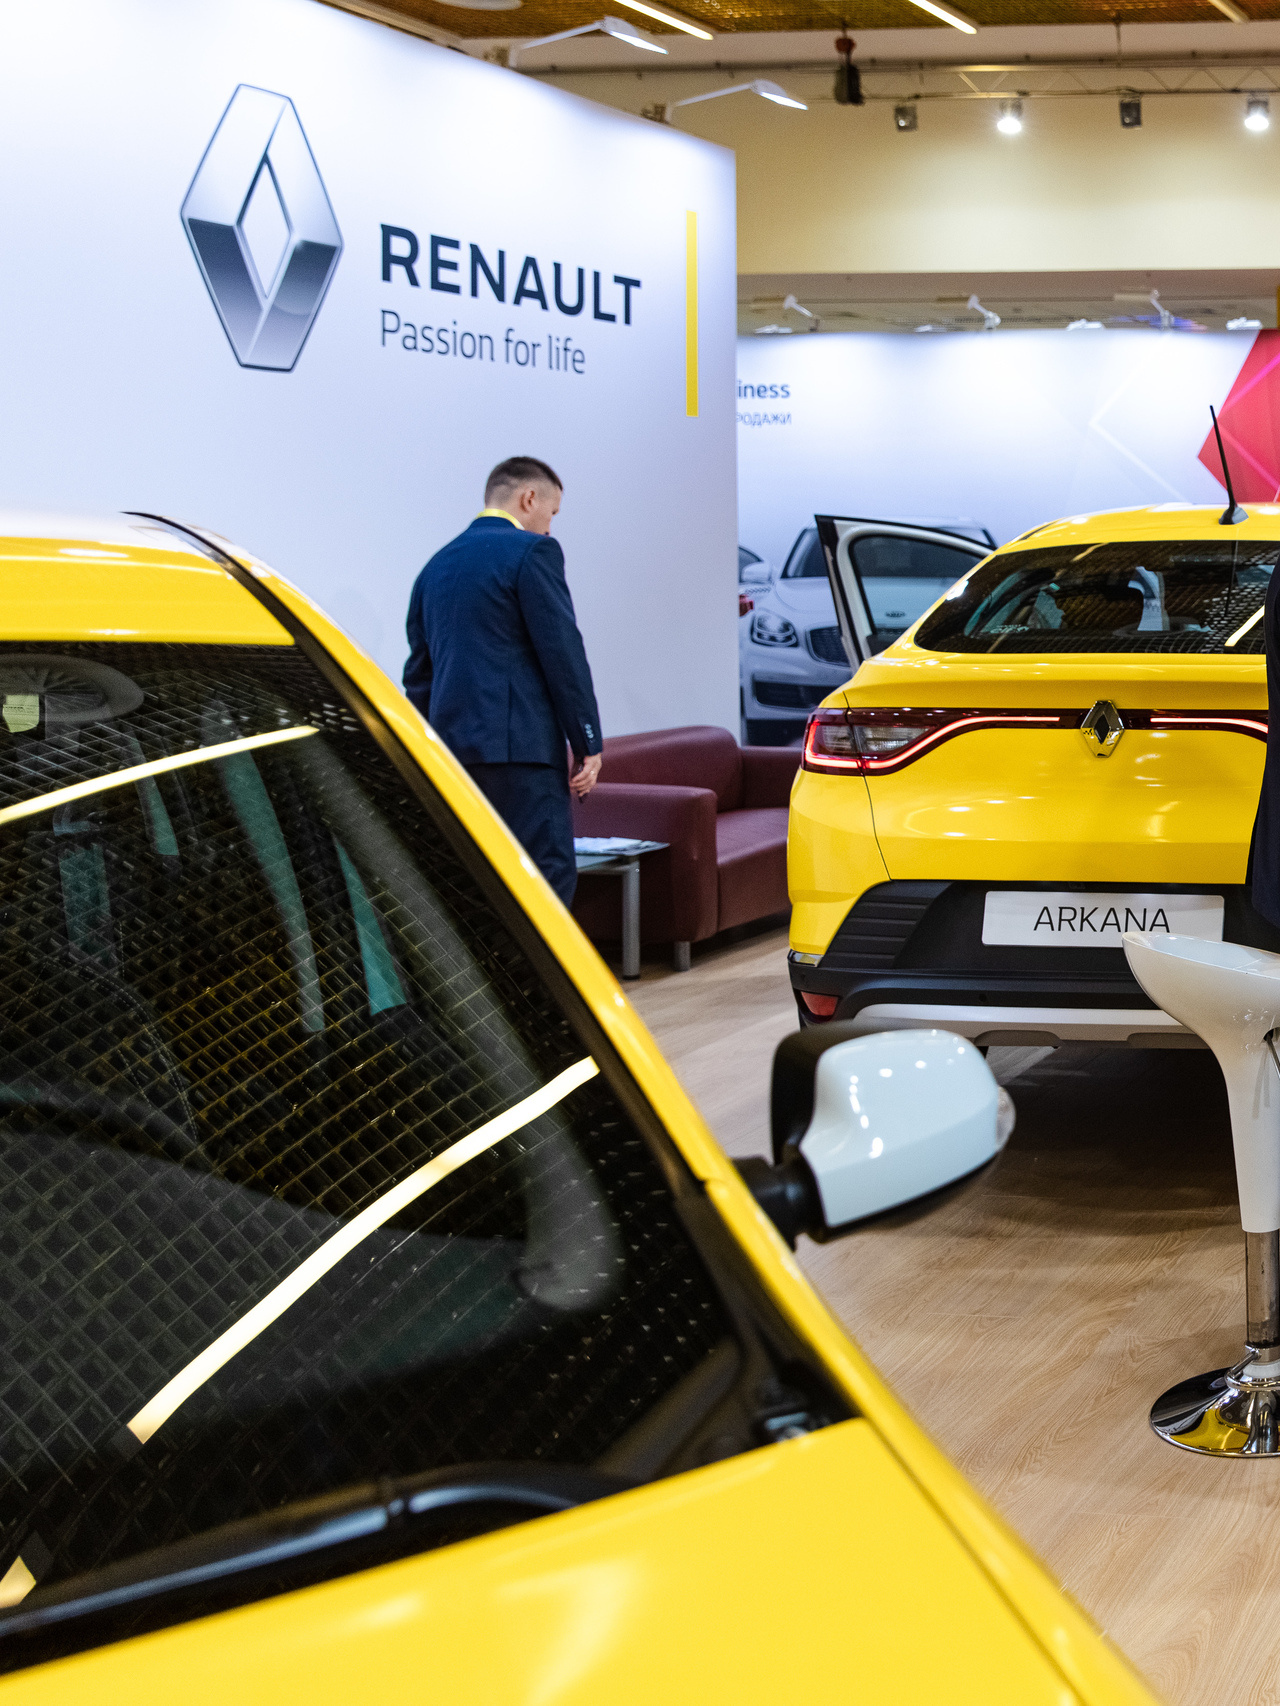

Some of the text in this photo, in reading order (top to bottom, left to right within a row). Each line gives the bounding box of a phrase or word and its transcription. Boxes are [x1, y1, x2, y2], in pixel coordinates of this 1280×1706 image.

[380, 223, 642, 326] RENAULT
[381, 309, 586, 375] Passion for life
[1033, 906, 1170, 933] ARKANA
